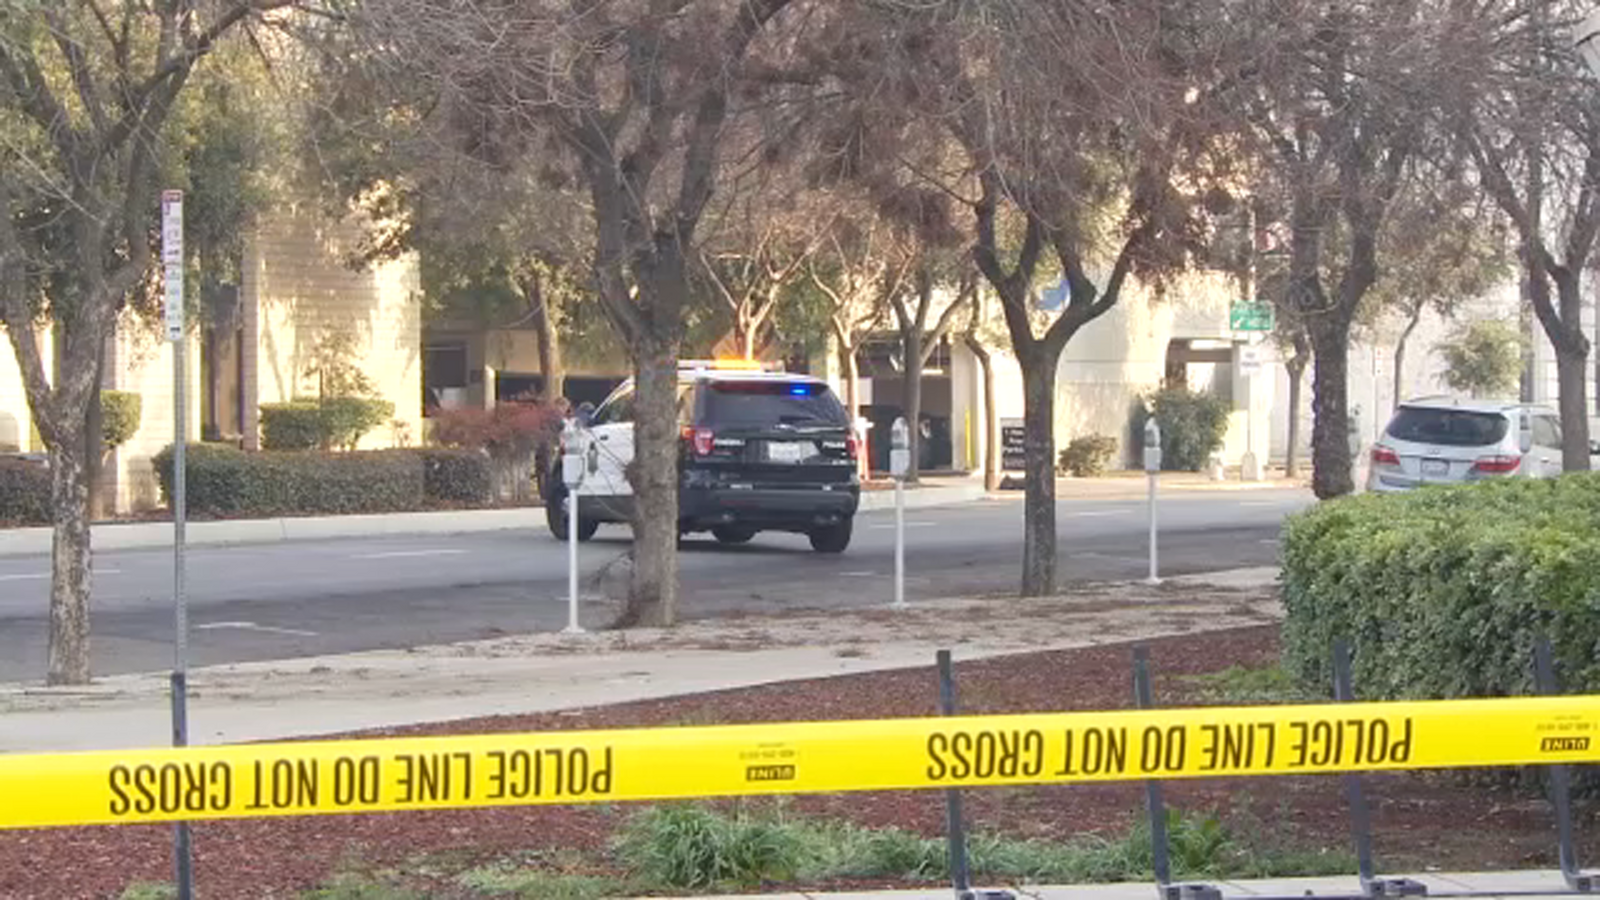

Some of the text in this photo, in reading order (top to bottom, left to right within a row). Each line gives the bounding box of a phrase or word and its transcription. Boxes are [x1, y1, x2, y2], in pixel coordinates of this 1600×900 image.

[109, 746, 612, 816] POLICE LINE DO NOT CROSS
[926, 717, 1412, 781] POLICE LINE DO NOT CROSS
